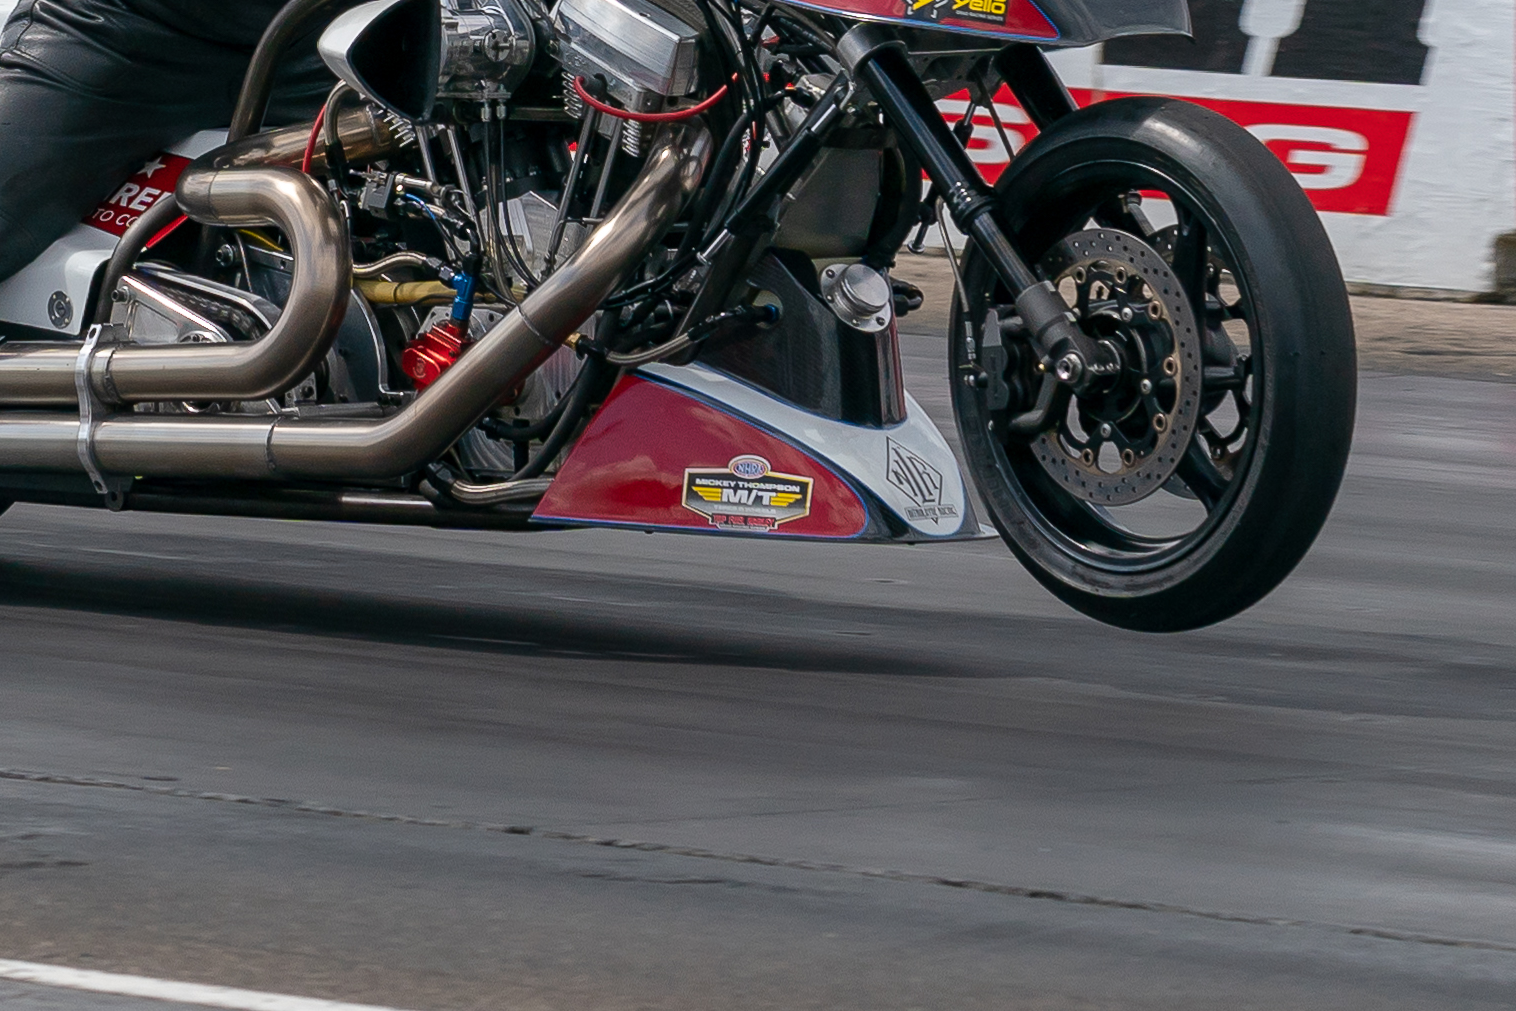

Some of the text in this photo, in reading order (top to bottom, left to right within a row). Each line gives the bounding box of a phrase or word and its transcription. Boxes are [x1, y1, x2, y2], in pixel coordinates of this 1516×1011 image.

[737, 462, 765, 476] NHRA
[695, 478, 800, 492] MICKEY THOMPSON
[722, 488, 777, 505] M/T
